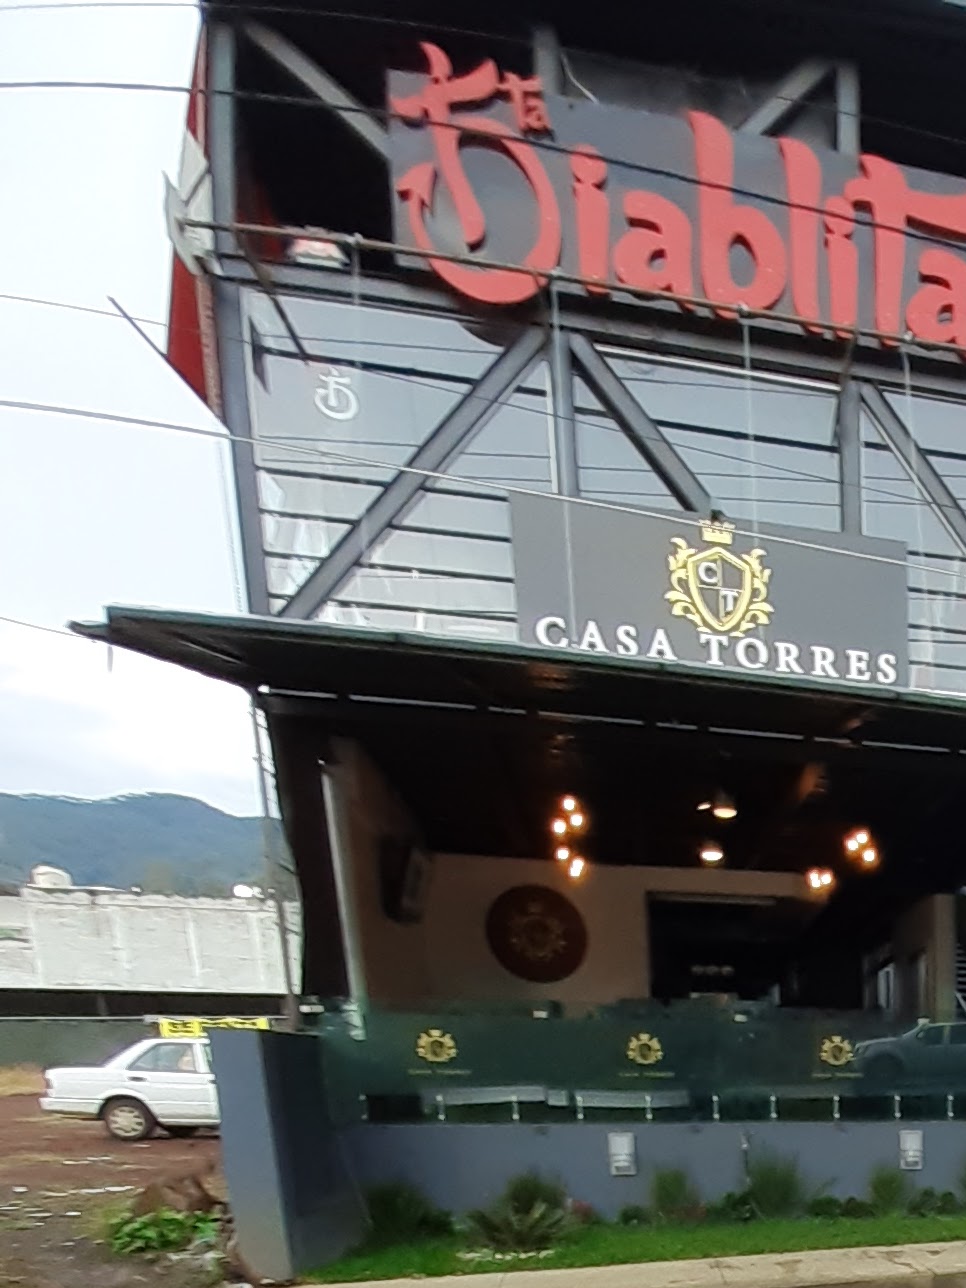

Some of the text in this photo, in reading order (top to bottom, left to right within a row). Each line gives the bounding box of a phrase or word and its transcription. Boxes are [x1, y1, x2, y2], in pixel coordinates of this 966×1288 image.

[698, 561, 718, 584] C
[721, 589, 738, 612] T
[535, 616, 898, 684] CASA TORRES
